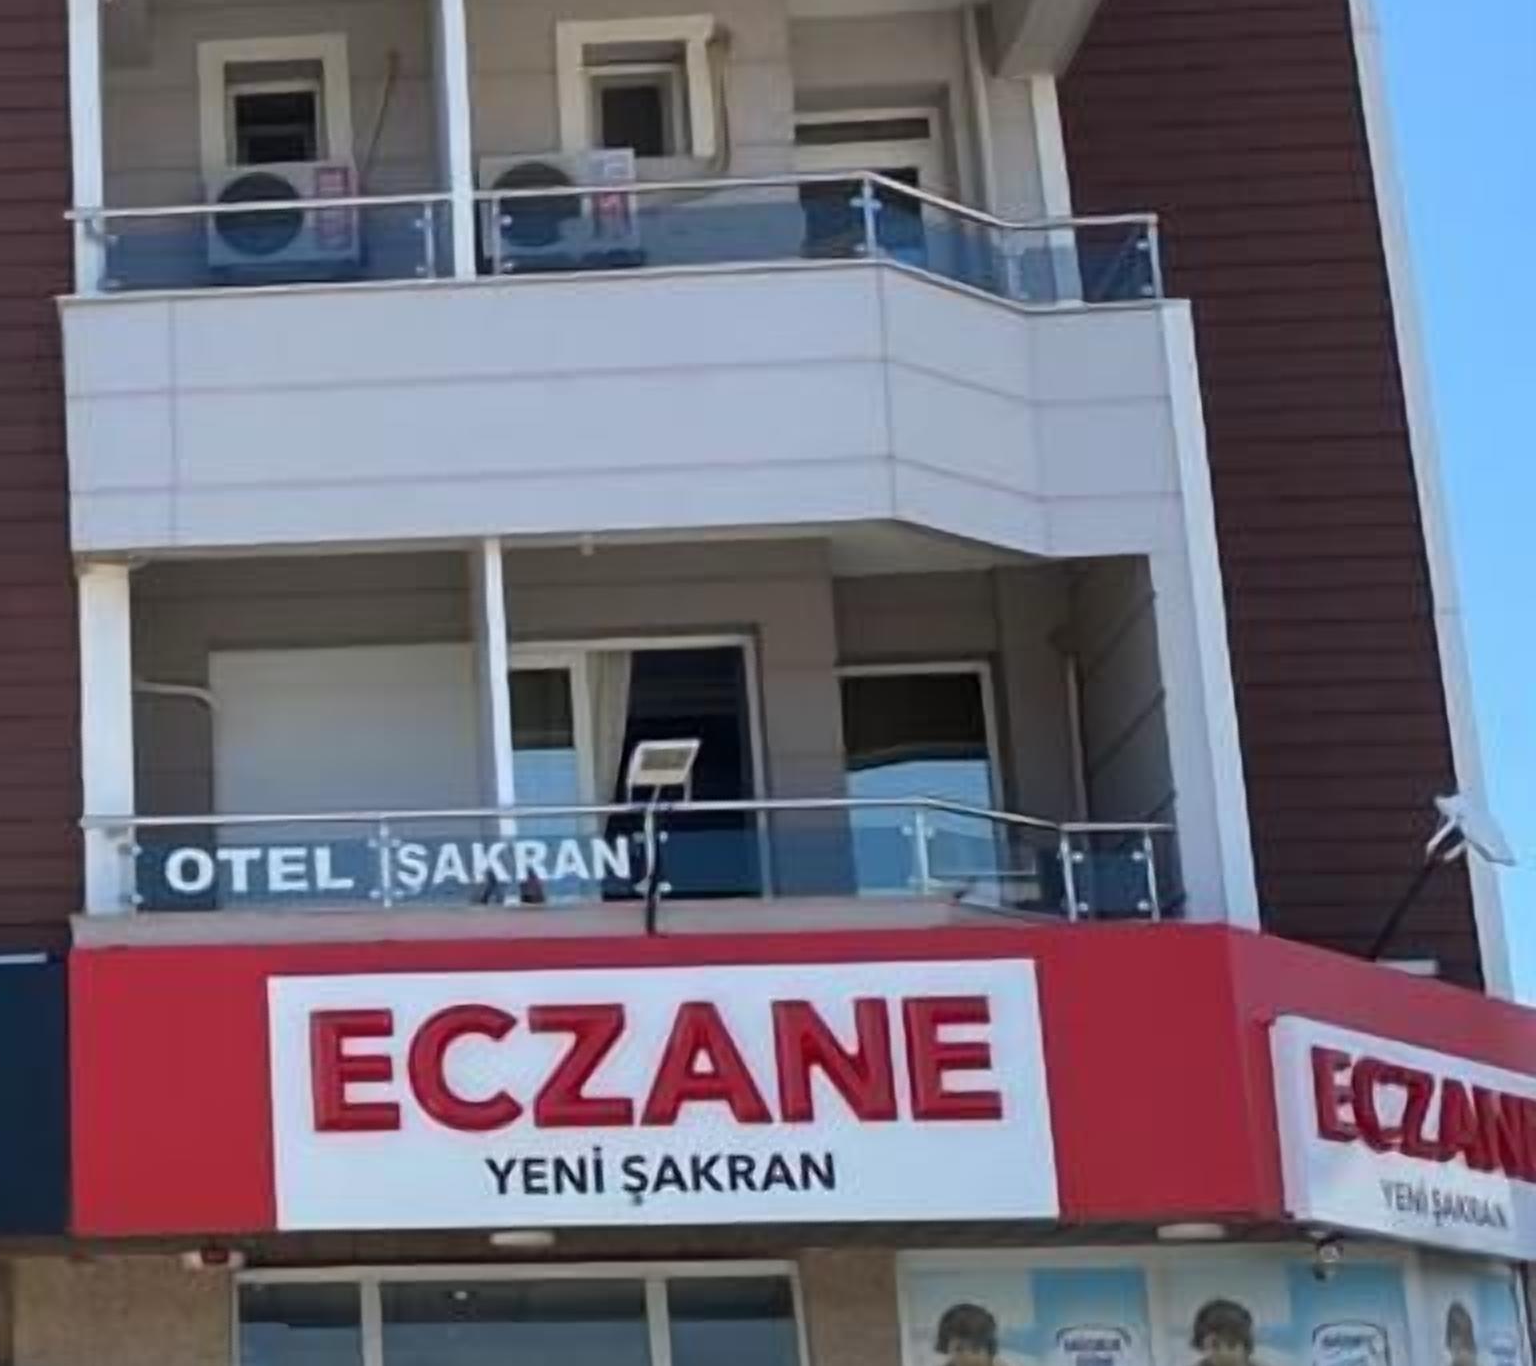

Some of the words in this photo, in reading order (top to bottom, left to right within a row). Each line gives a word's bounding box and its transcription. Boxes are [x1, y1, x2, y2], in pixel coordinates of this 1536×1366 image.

[165, 846, 354, 893] OTEL
[308, 995, 1005, 1133] ECZANE
[485, 1147, 606, 1197] YENİ
[621, 1152, 837, 1205] ŞAKRAN
